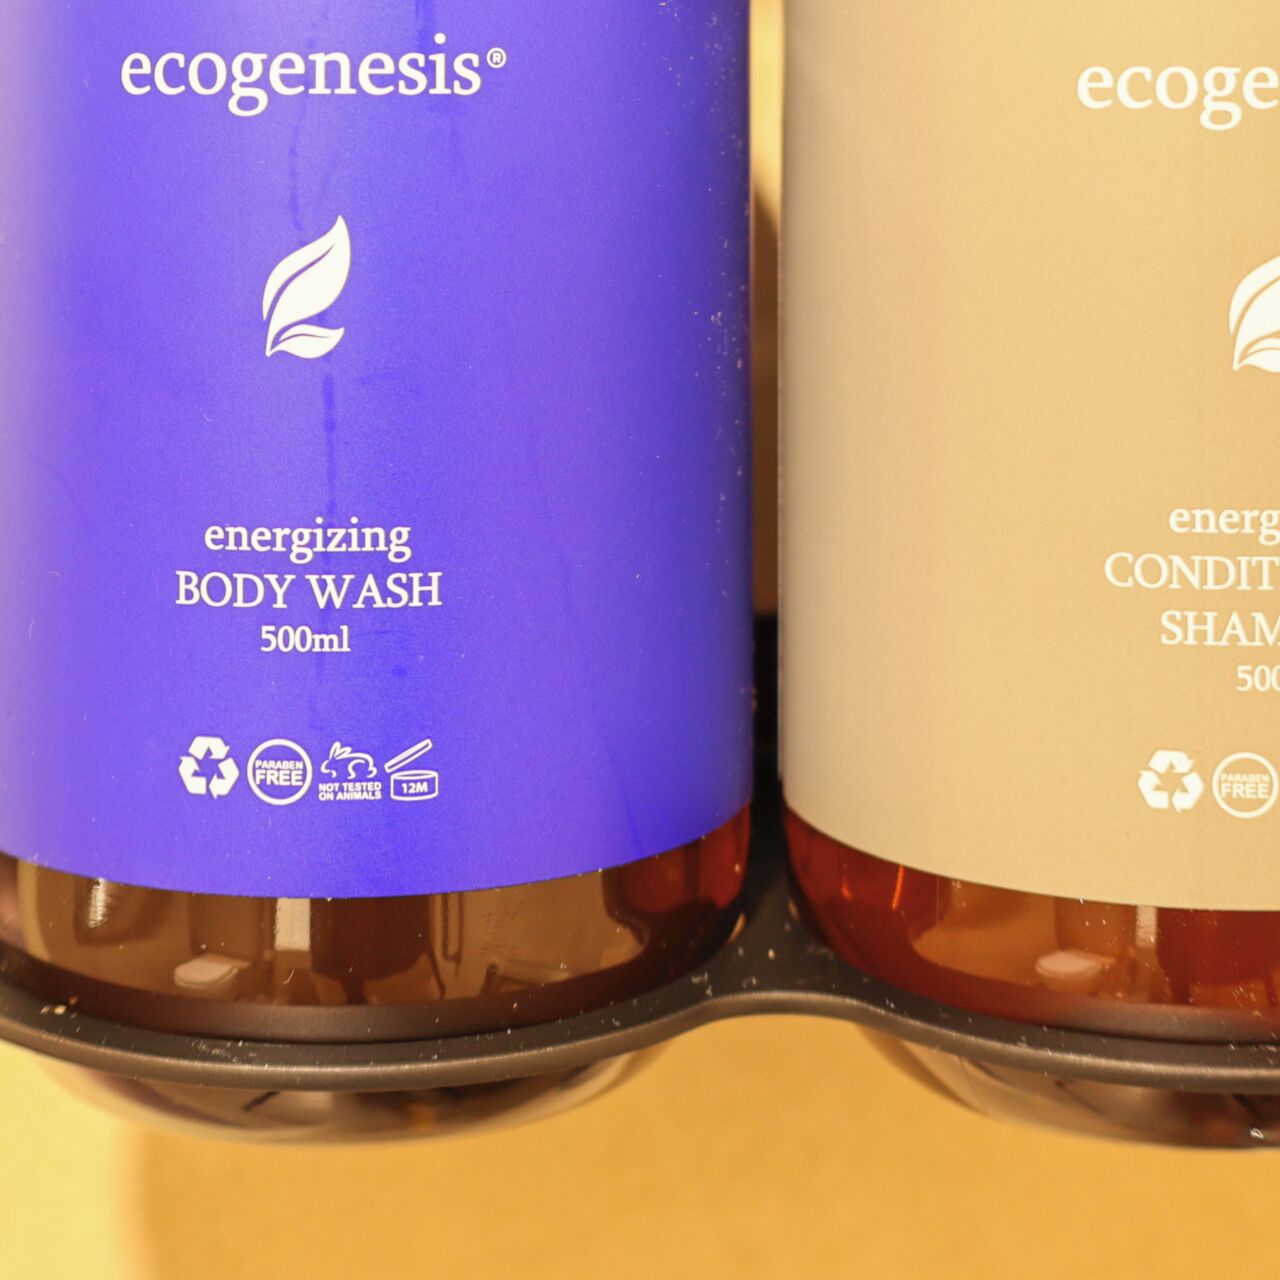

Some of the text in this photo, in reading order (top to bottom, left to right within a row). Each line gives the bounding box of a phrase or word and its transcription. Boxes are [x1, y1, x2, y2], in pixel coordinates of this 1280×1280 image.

[204, 516, 412, 564] energizing
[174, 570, 444, 609] BODY WASH
[260, 624, 351, 654] 500ml
[254, 759, 304, 769] PARABEN
[256, 770, 304, 786] FREE
[1220, 773, 1270, 783] PARABEN
[318, 782, 382, 792] NOT TESTED
[401, 782, 429, 794] 12M
[1220, 783, 1270, 799] FREE
[318, 791, 382, 801] ON ANIMALS
